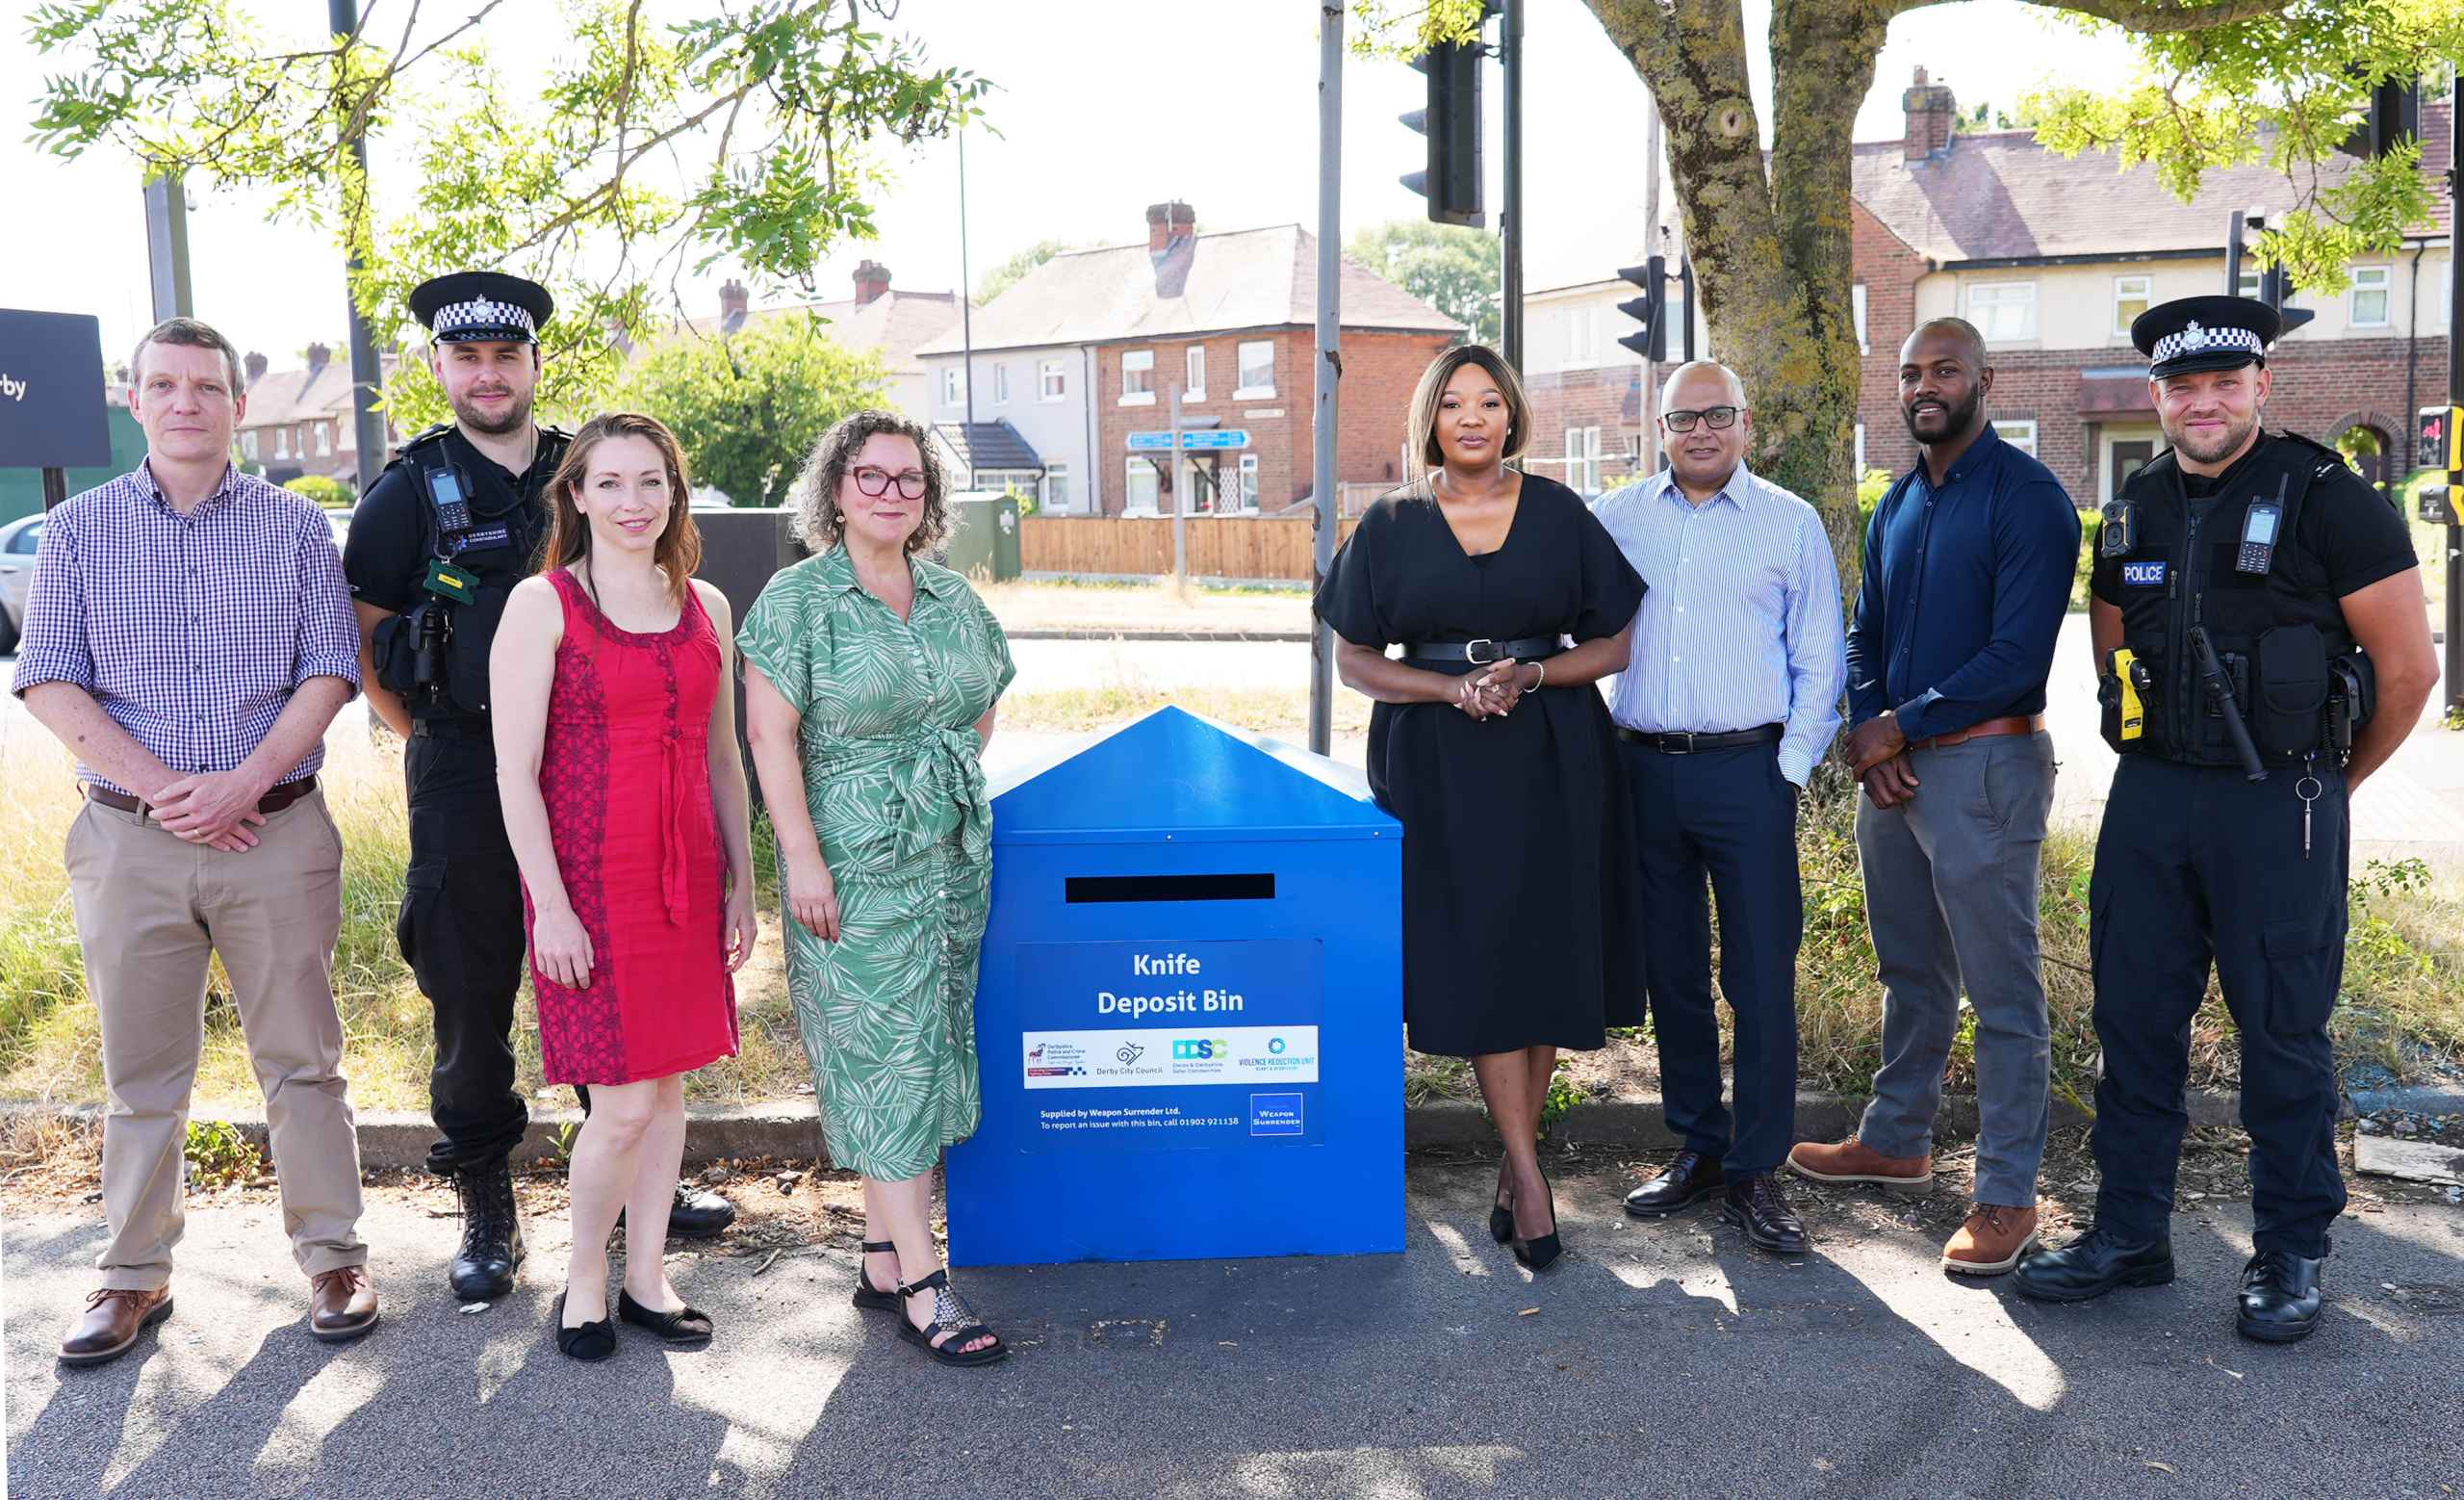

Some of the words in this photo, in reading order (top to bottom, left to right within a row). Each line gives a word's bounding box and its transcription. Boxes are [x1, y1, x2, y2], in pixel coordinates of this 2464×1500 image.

[2124, 565, 2163, 582] POLICE
[1133, 953, 1201, 975] Knife
[1097, 991, 1196, 1019] Deposit
[1203, 990, 1244, 1011] Bin
[1172, 1038, 1228, 1060] DDSC
[1268, 1057, 1300, 1066] REDUCTION
[1096, 1068, 1118, 1076] Derby
[1119, 1067, 1134, 1075] City
[1136, 1066, 1163, 1074] Council
[1040, 1110, 1076, 1120] Supplied
[1077, 1109, 1088, 1119] by
[1089, 1109, 1122, 1118] Weapon
[1123, 1108, 1164, 1117] Surrender
[1052, 1122, 1076, 1130] report
[1147, 1119, 1162, 1127] bin,
